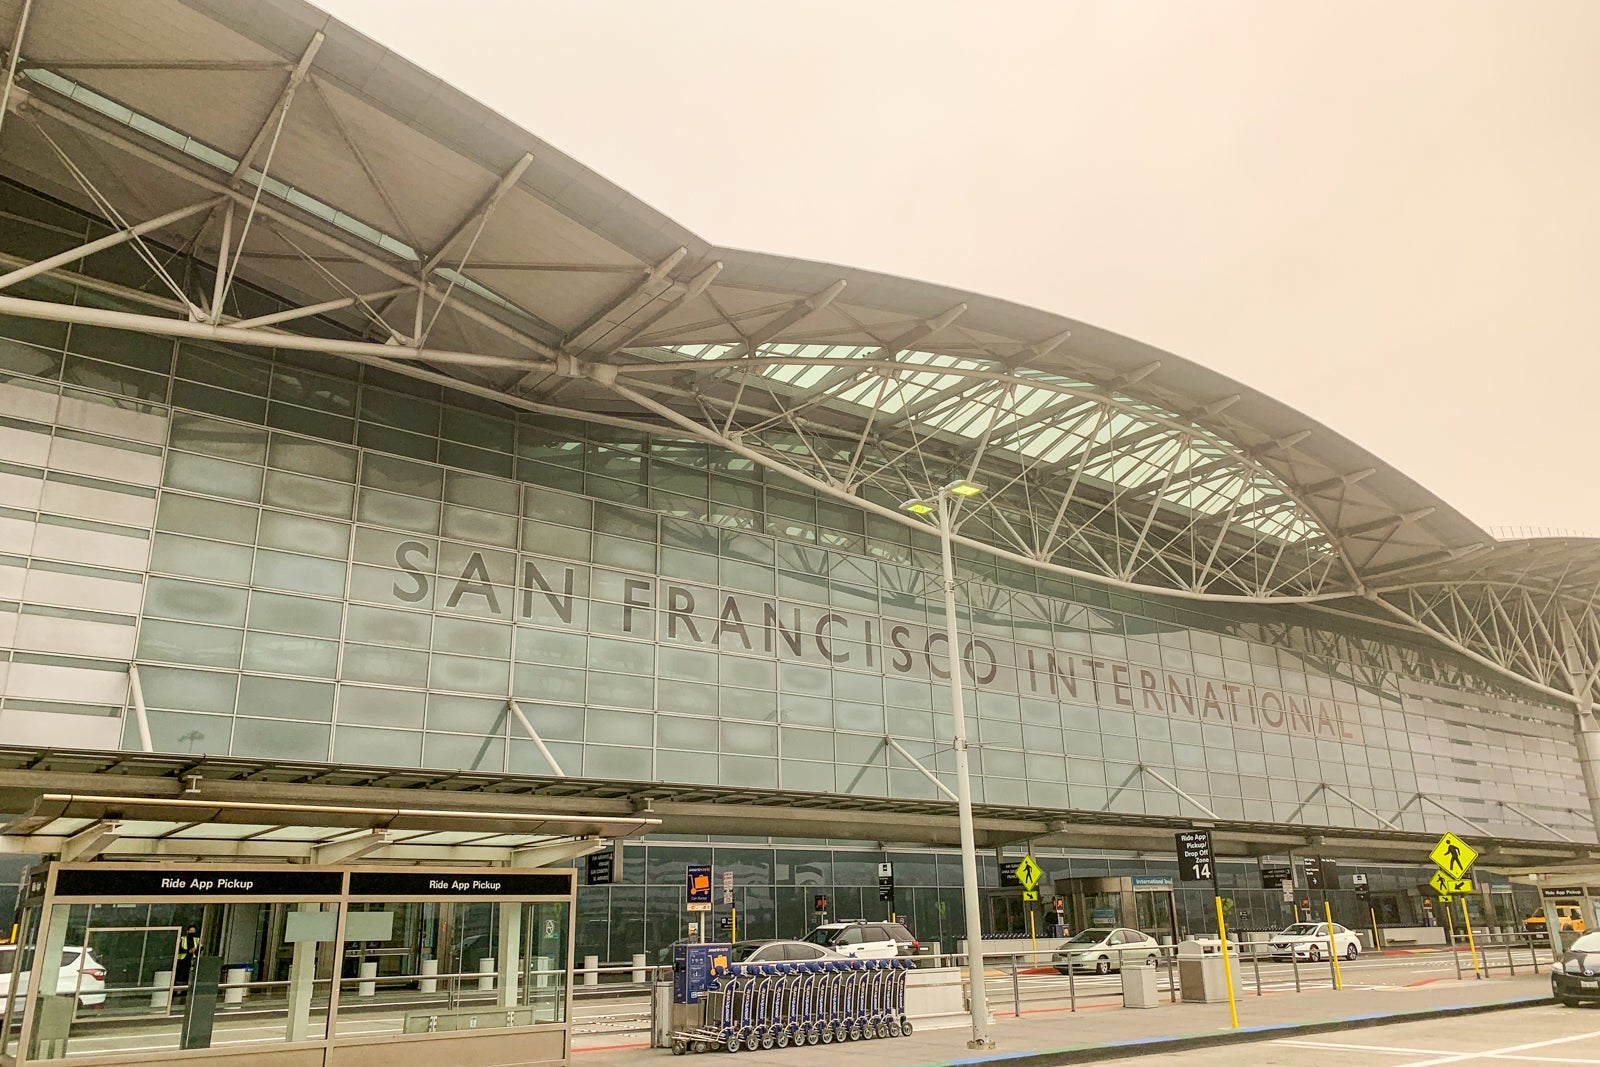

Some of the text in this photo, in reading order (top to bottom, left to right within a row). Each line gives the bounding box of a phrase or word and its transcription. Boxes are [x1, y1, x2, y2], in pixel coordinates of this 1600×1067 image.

[393, 540, 1353, 739] SAN FRANCISCO INTERNATIONAL
[1184, 850, 1199, 858] Drop
[1192, 864, 1211, 880] 14
[161, 878, 254, 890] Ride App Pickup
[429, 880, 501, 891] Ride App Pickup
